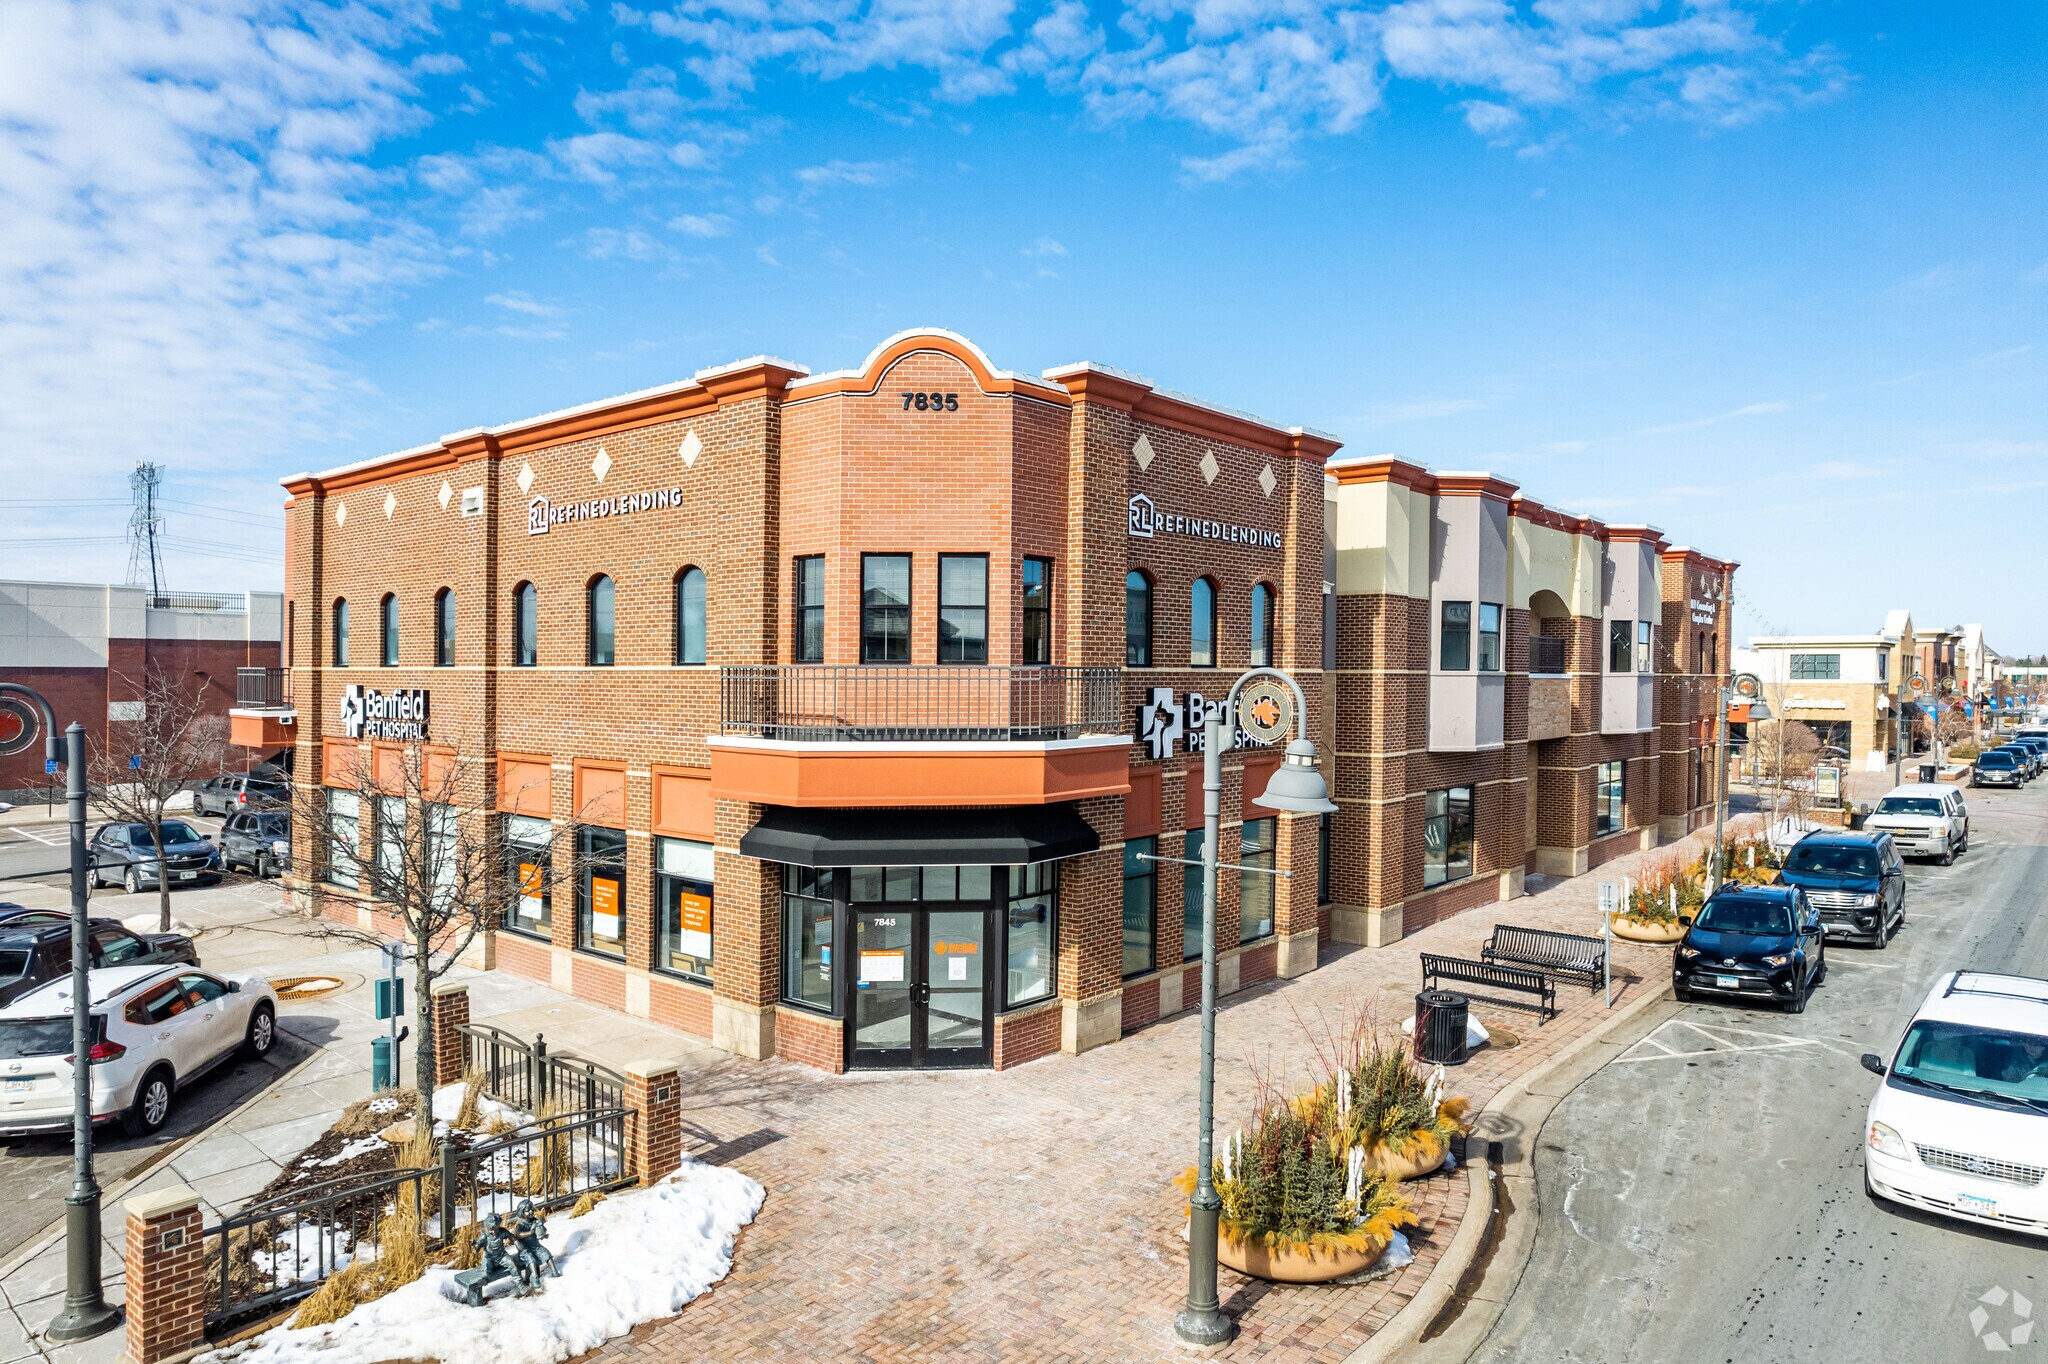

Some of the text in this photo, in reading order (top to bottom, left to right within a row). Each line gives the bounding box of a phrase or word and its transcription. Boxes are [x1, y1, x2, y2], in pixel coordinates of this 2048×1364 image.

[901, 392, 959, 411] 7835
[366, 689, 424, 720] Banfield
[367, 720, 424, 739] PET HOSPITAL
[874, 918, 896, 926] 7845
[1980, 1200, 1996, 1212] 343
